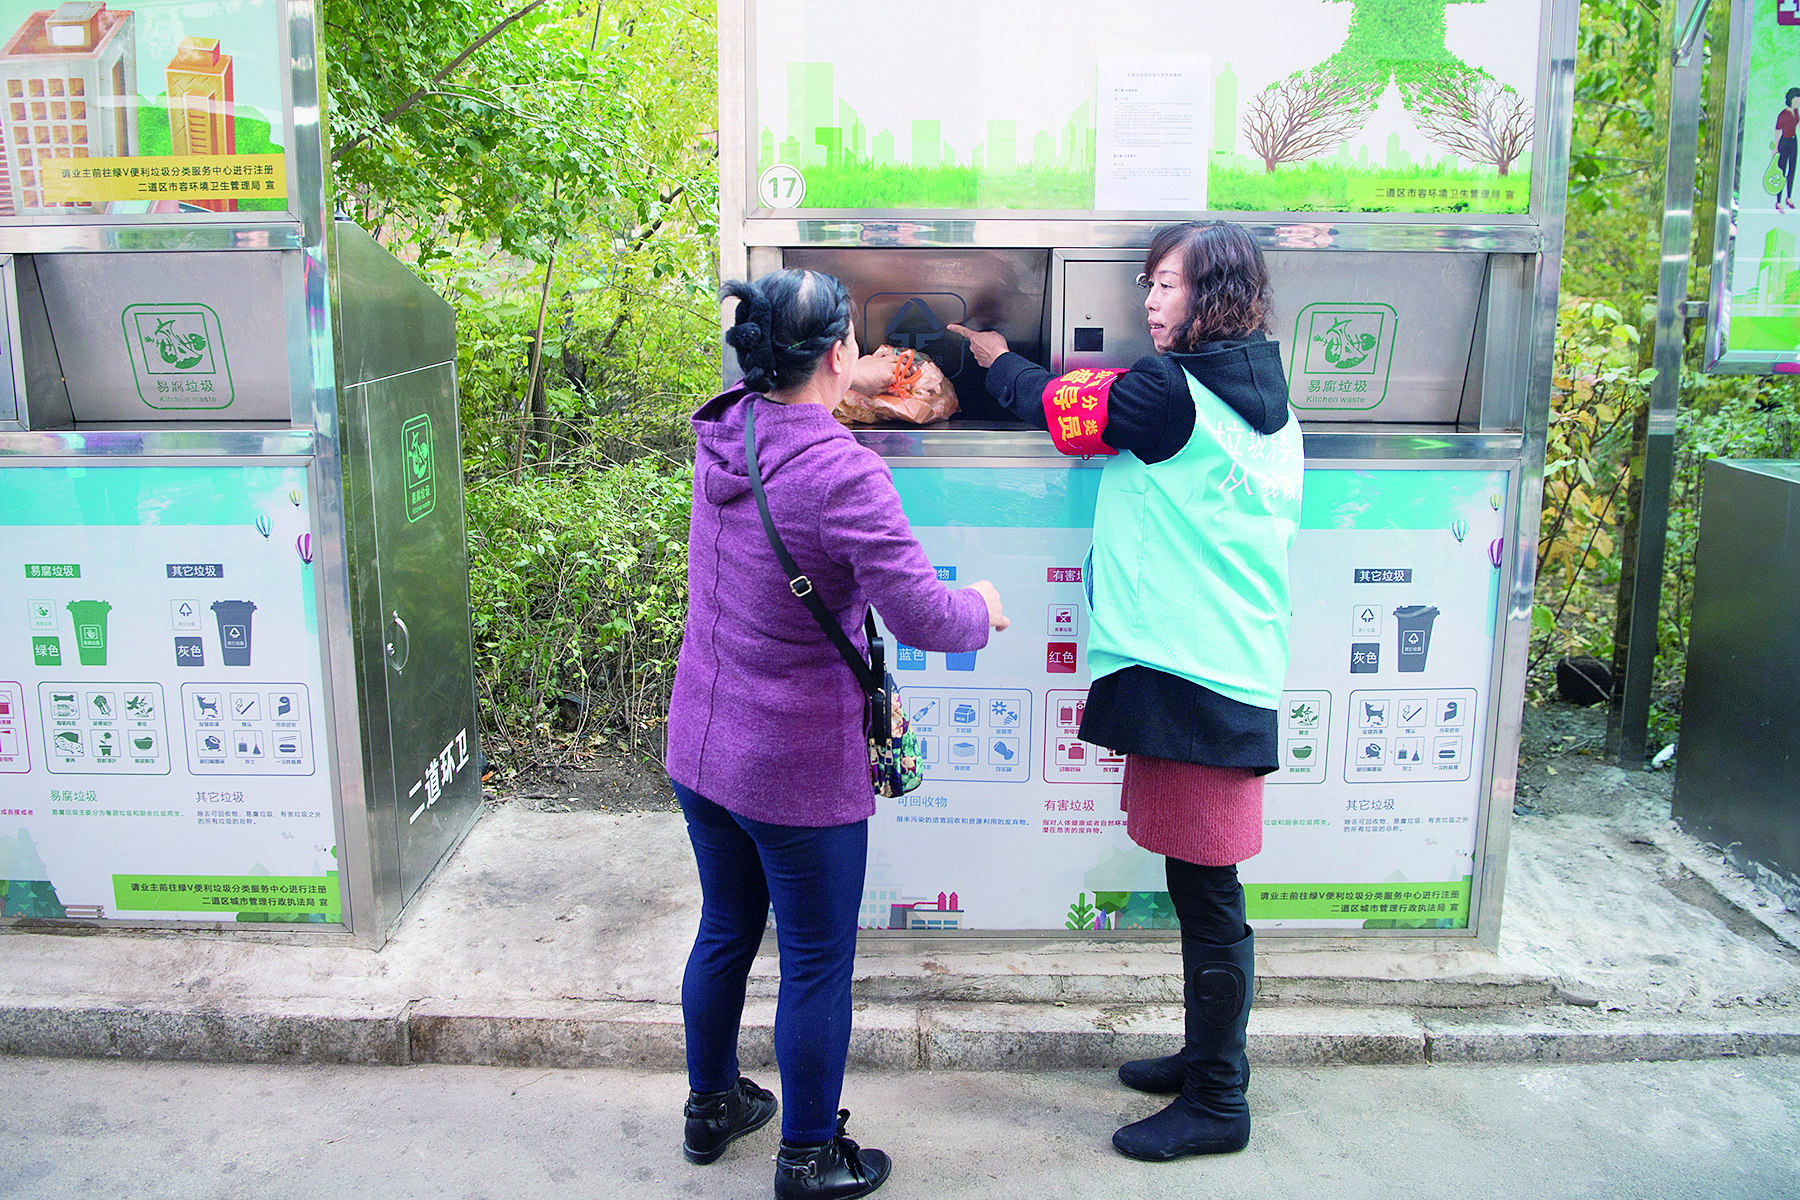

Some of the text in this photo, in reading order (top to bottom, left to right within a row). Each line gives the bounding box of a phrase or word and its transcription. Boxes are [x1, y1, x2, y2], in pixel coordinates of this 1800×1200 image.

[61, 165, 274, 178] 请业主前往绿V便利垃圾分类服务中心进行注册
[138, 180, 275, 192] 二道区市容环境卫生管理局 宣
[768, 177, 796, 198] 17
[1375, 188, 1515, 200] 二道区市容环境卫生管理局 宣
[1308, 379, 1367, 393] 易腐垃圾
[159, 395, 190, 403] Kitchen
[1306, 395, 1339, 403] Kitchen
[30, 565, 75, 577] 易腐垃圾
[171, 565, 217, 577] 其它垃圾
[1359, 570, 1405, 582] 其它垃圾
[35, 644, 60, 657] 绿色
[177, 645, 203, 658] 灰色
[899, 648, 925, 661] 蓝色
[1049, 651, 1075, 664] 红色
[1353, 651, 1378, 664] 灰色
[409, 728, 469, 825] 二道环卫
[50, 790, 98, 803] 易腐垃圾
[196, 791, 245, 803] 其它垃圾
[898, 796, 948, 808] 可回收物
[1044, 799, 1095, 812] 有害垃圾
[1346, 799, 1395, 811] 其它垃圾
[131, 882, 327, 894] 请业主前往绿V便利垃圾分类服务中心进行注册
[202, 896, 329, 907] 二道区城市管理行政执法局 宣
[1260, 890, 1460, 901] 请业主前往绿V便利垃圾分类服务中心进行注册
[1331, 902, 1459, 913] 二道区城市管理行政执法局 宣
